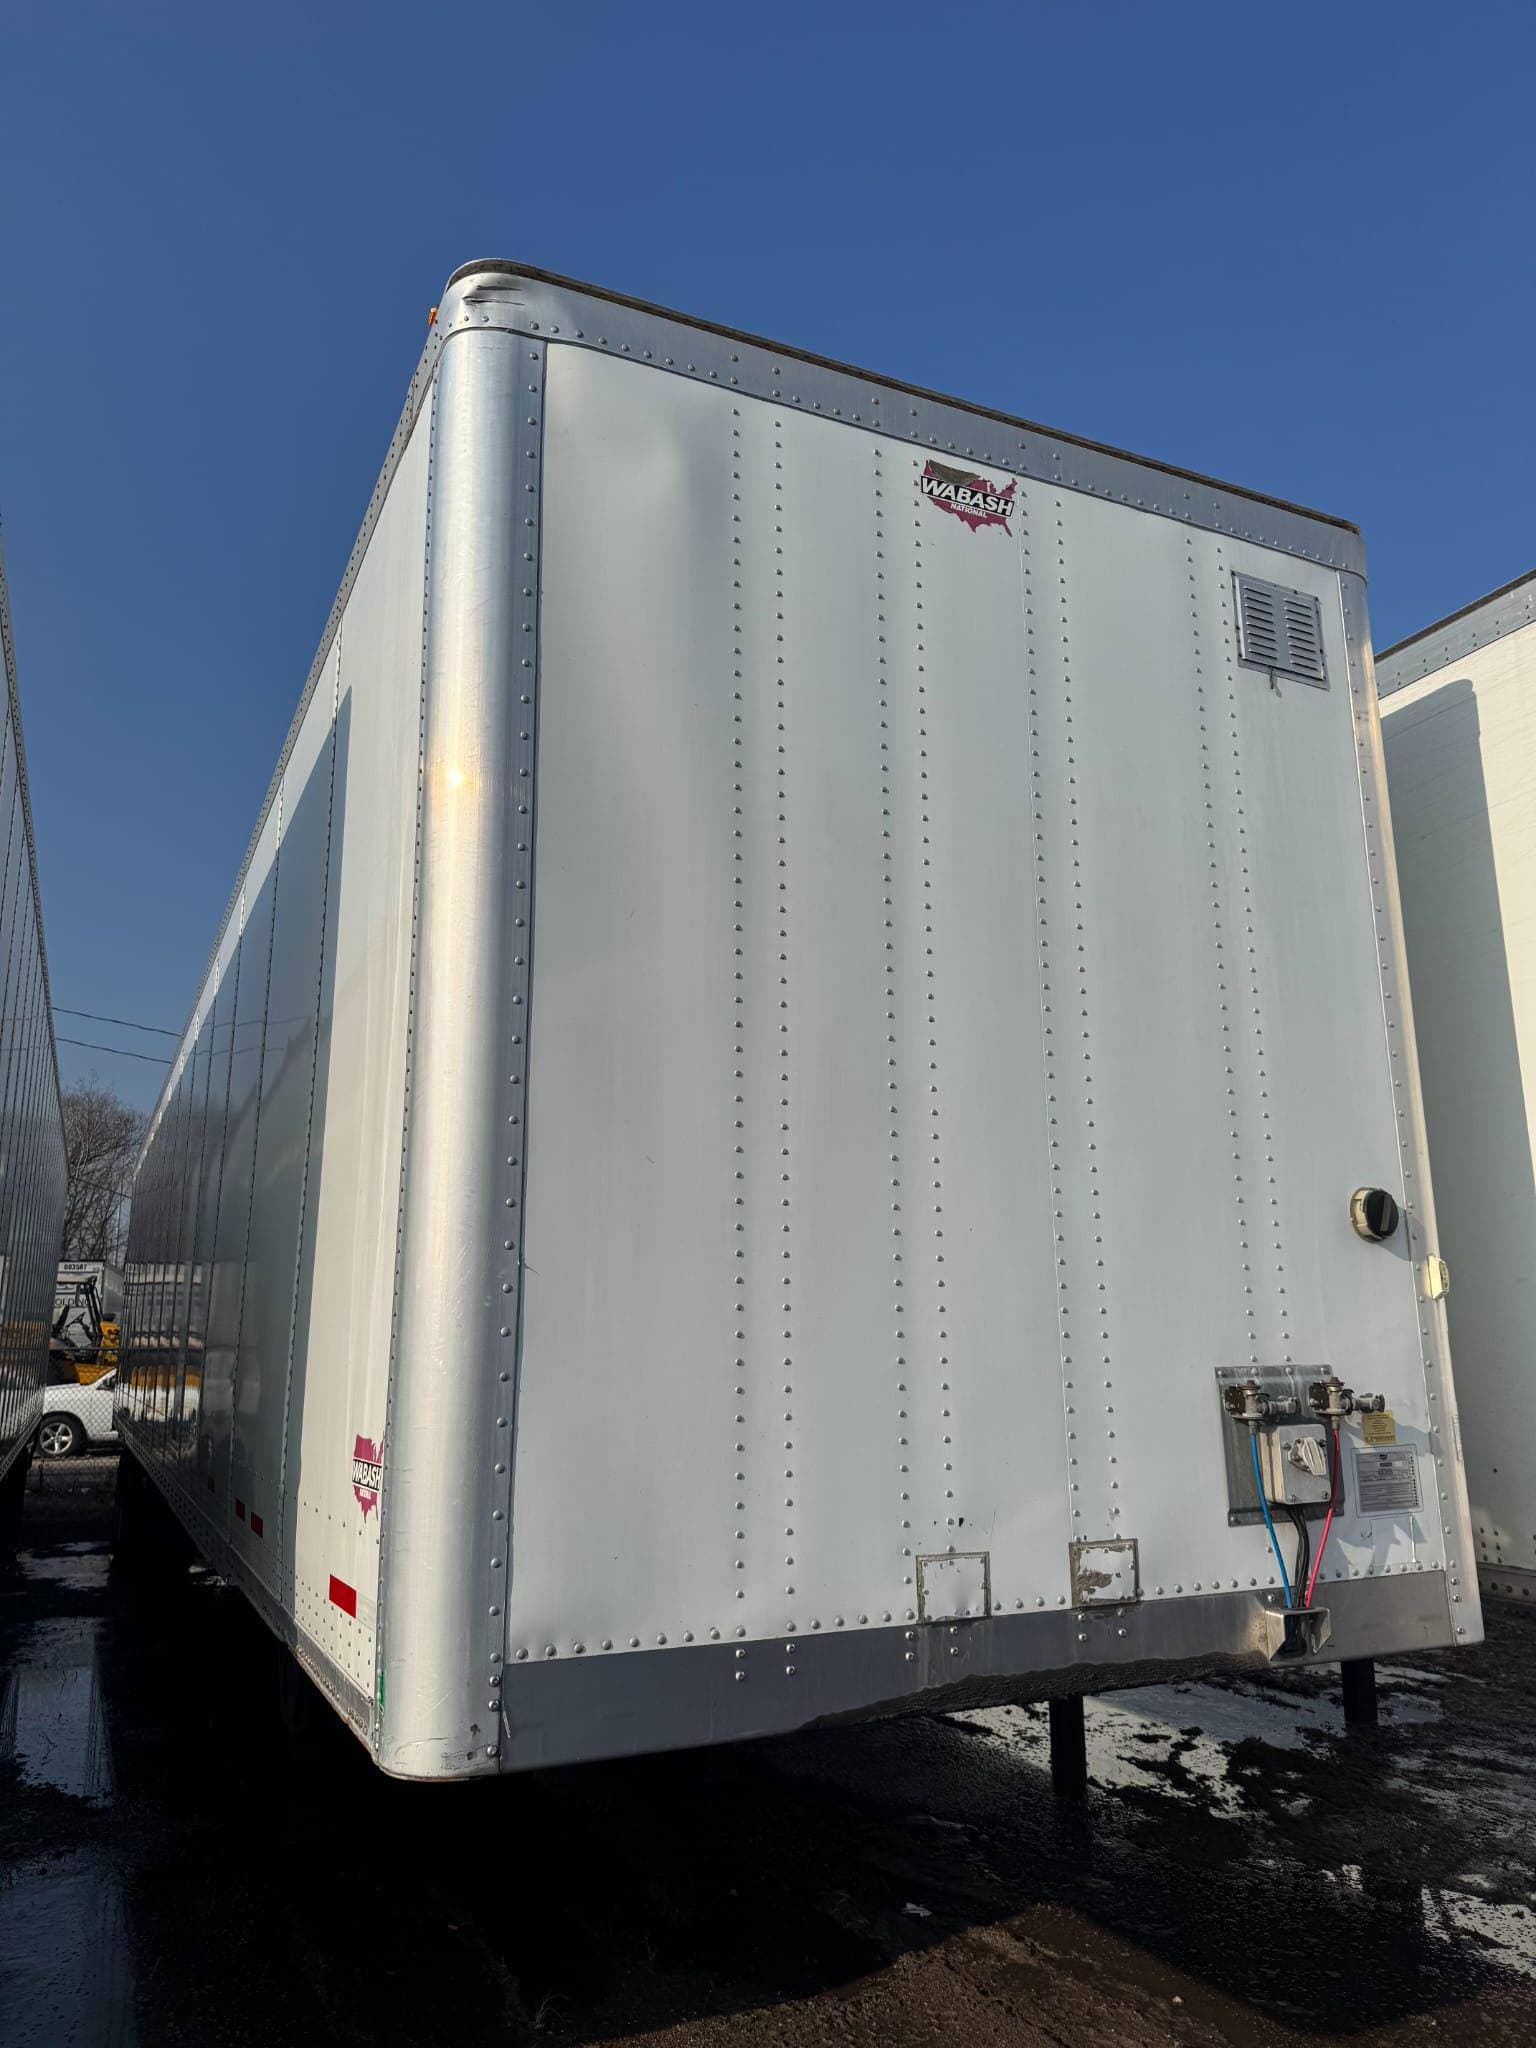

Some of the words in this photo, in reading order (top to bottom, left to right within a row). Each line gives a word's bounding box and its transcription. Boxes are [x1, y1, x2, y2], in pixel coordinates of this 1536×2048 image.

[921, 477, 1014, 516] WABASH
[950, 503, 988, 519] NATIONAL
[352, 1460, 382, 1489] WABASH
